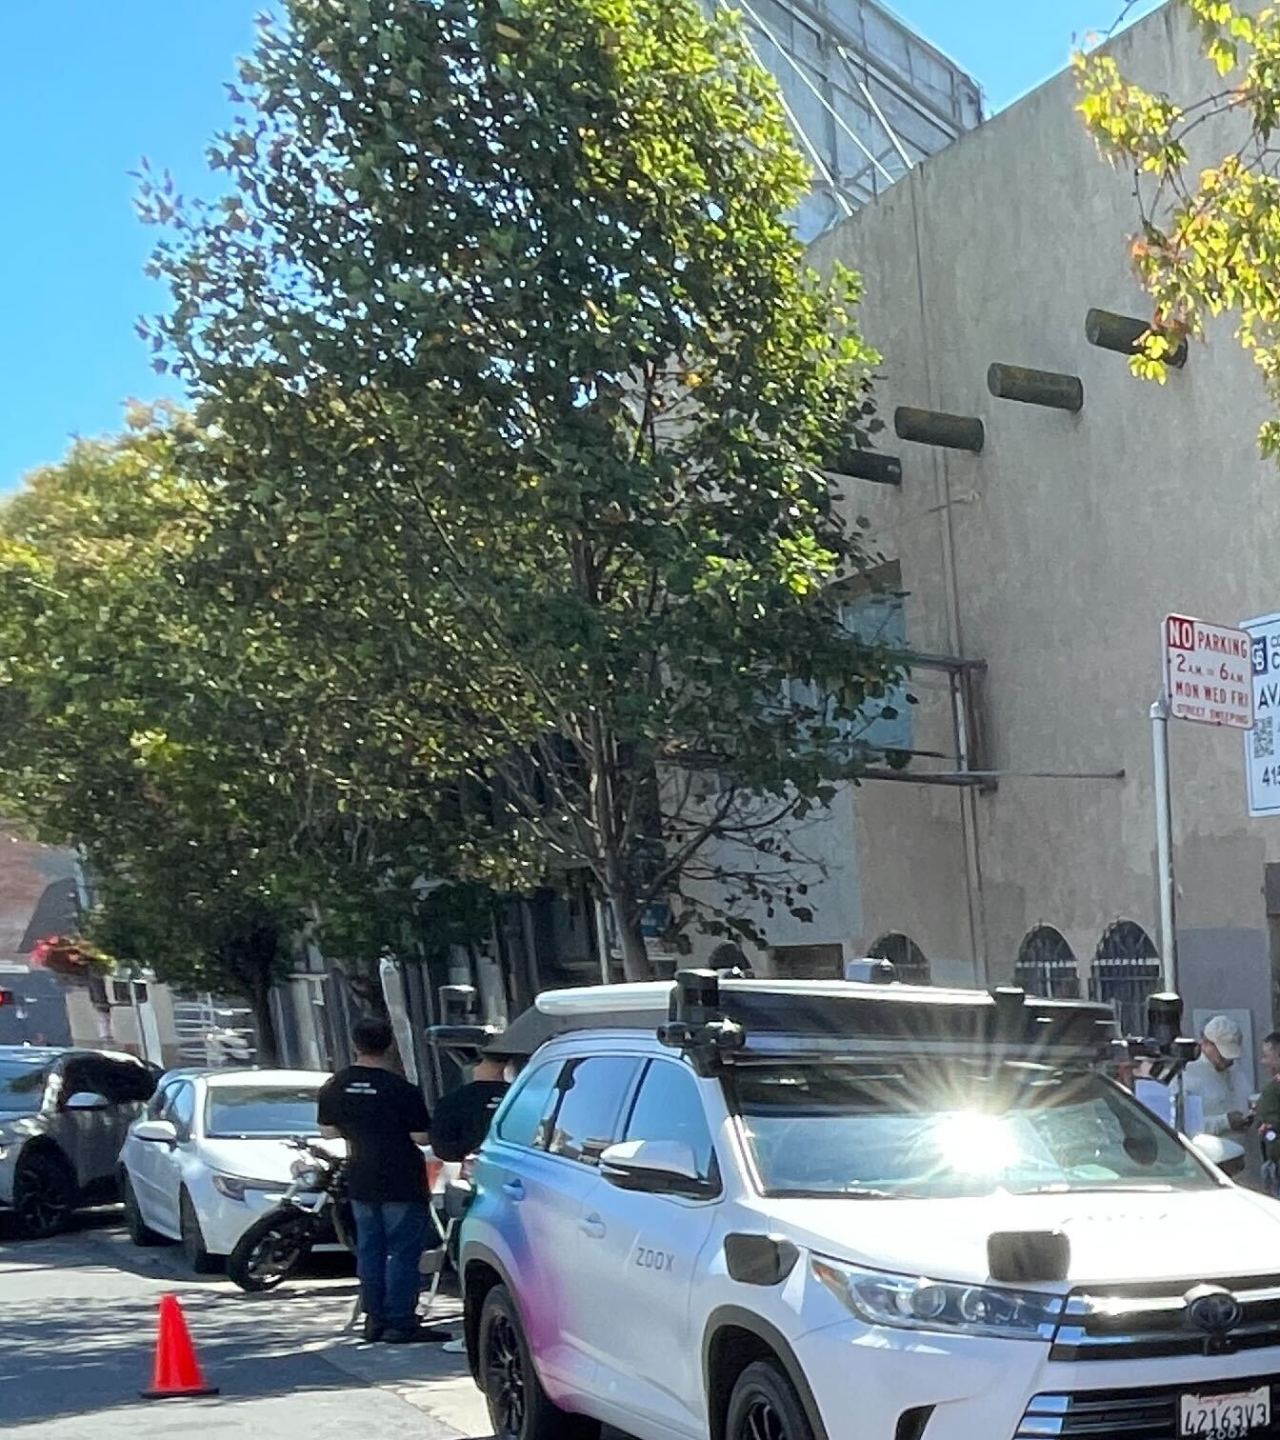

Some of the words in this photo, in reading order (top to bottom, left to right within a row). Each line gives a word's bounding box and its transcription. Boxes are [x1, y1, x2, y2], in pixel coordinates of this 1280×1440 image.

[1168, 618, 1193, 650] NO
[1198, 630, 1249, 659] PARKING
[1176, 653, 1186, 673] 2
[1219, 662, 1228, 681] 6
[1176, 681, 1199, 700] MON
[1203, 685, 1226, 704] WED
[1231, 690, 1249, 708] FRI
[1177, 703, 1205, 718] STREET
[636, 1247, 676, 1272] ZOOX
